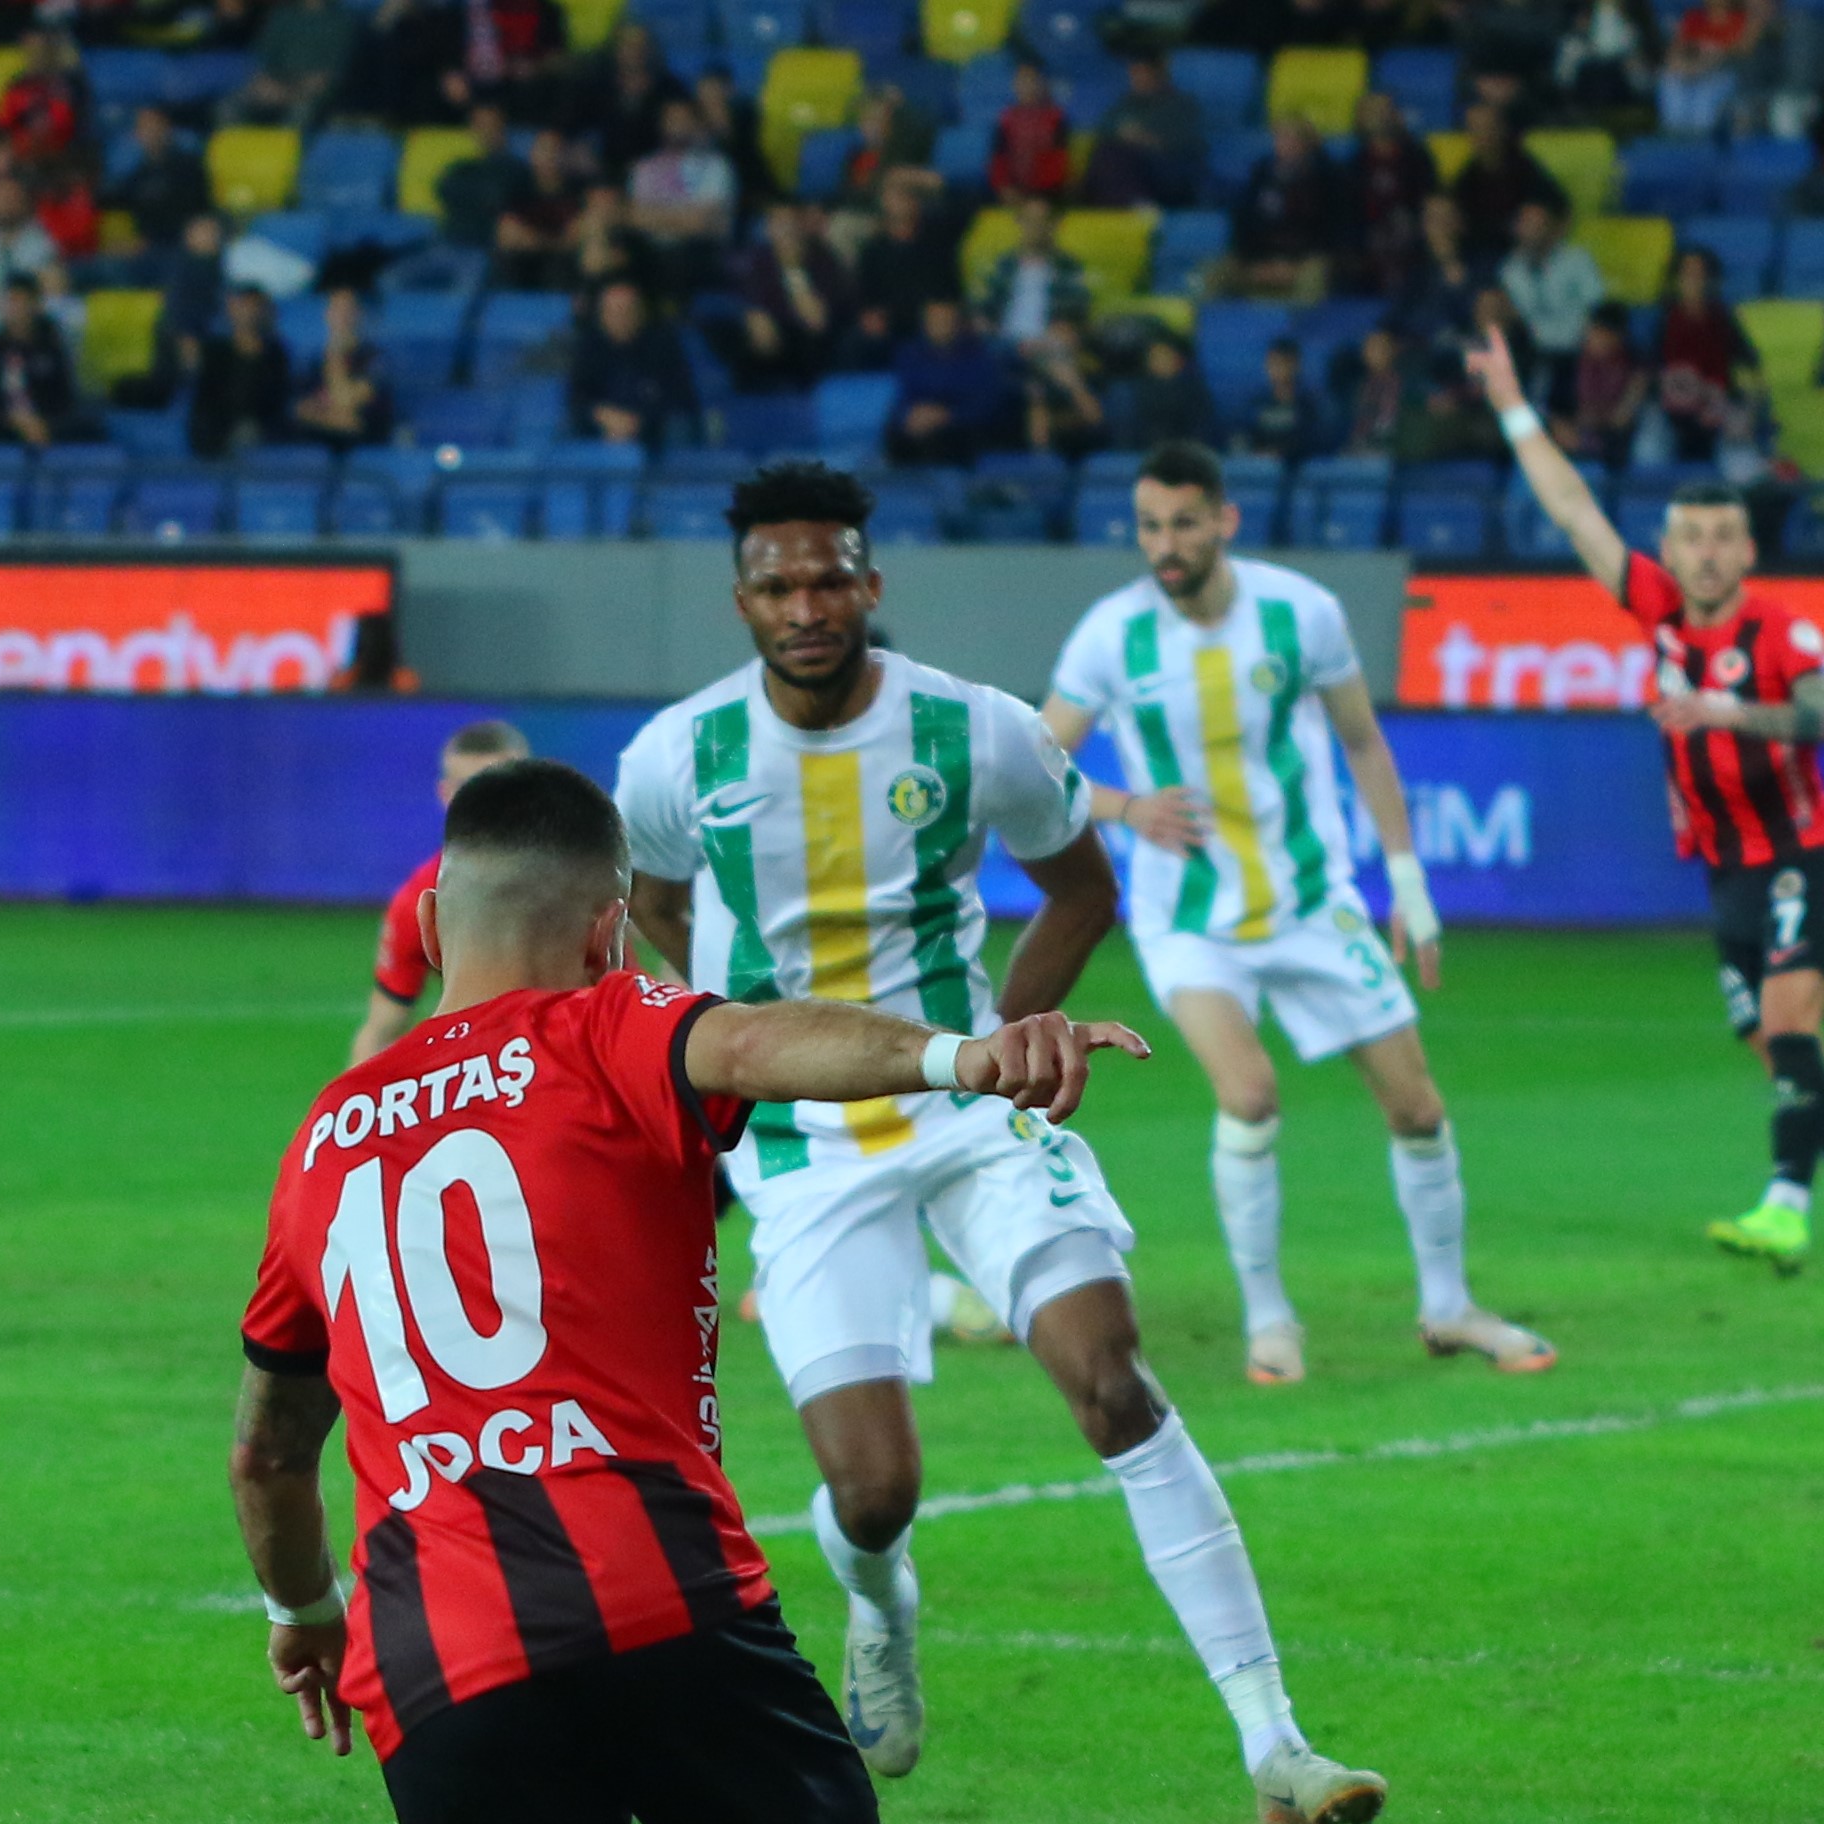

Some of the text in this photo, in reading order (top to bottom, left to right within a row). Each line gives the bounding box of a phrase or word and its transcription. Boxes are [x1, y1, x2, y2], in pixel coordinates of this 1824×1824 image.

[303, 1036, 537, 1172] PORTAŞ
[320, 1127, 549, 1424] 10
[388, 1399, 618, 1512] JOCA
